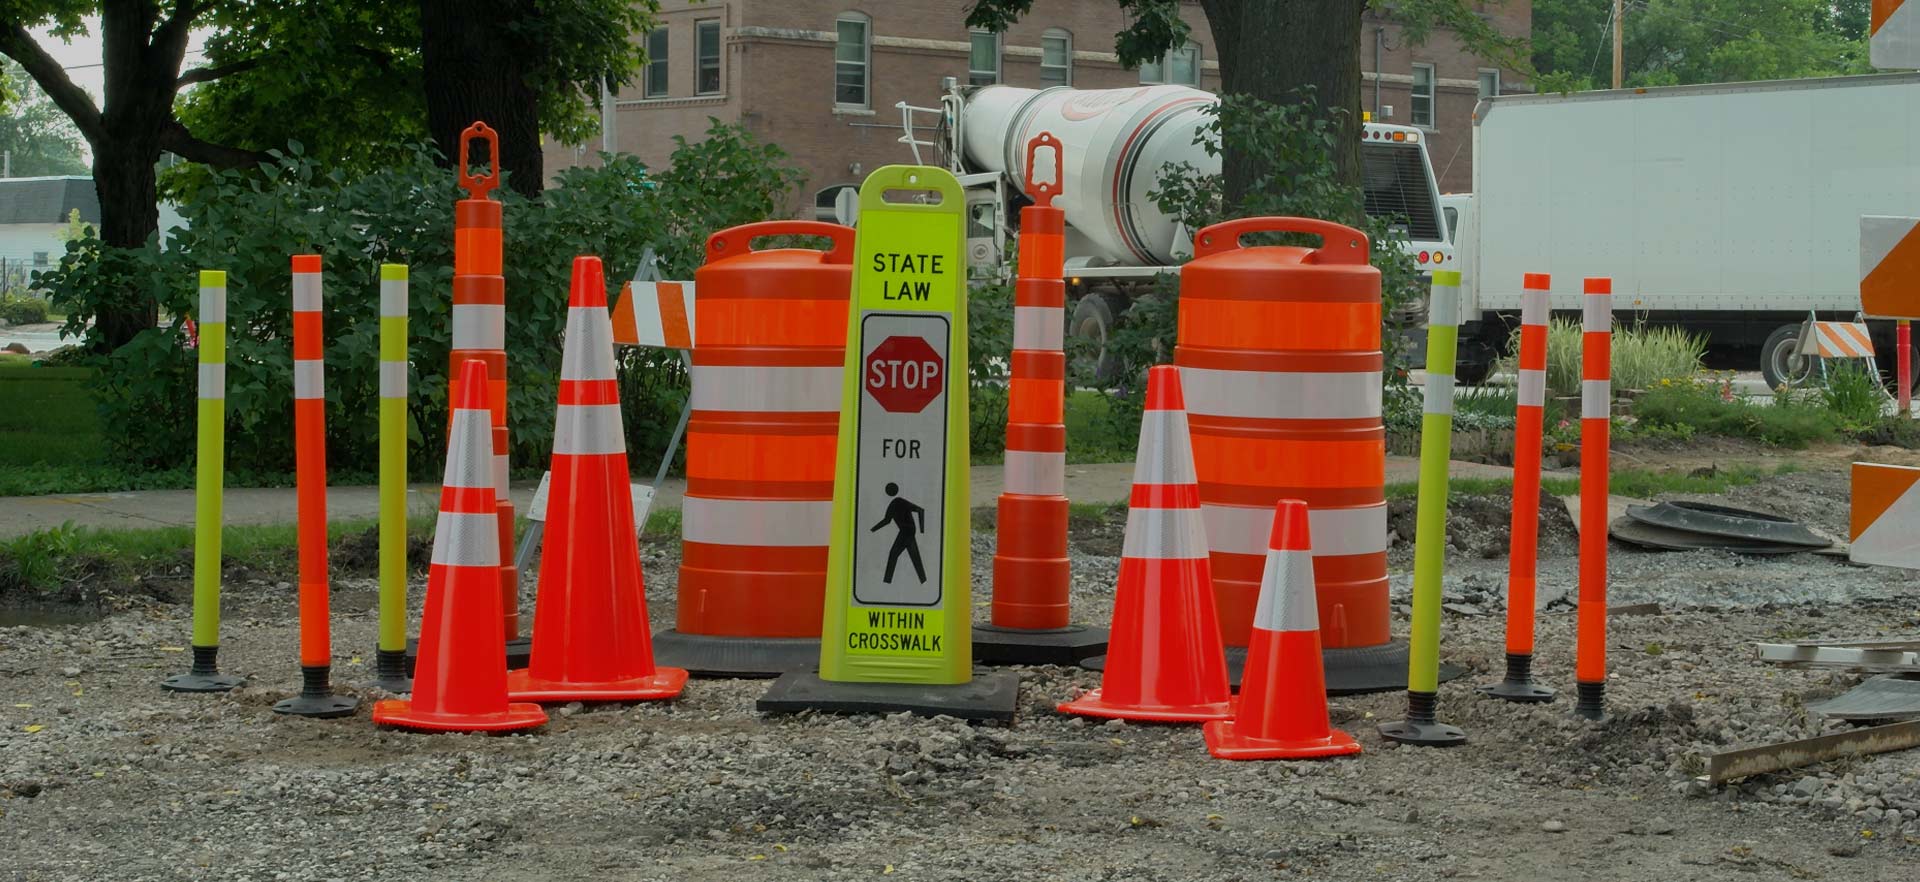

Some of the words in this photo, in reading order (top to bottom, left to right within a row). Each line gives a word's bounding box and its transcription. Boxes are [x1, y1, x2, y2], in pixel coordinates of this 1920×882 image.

[873, 253, 943, 274] STATE
[884, 280, 931, 301] LAW
[869, 359, 939, 389] STOP
[882, 438, 921, 459] FOR
[868, 611, 924, 629] WITHIN
[848, 632, 941, 652] CROSSWALK
